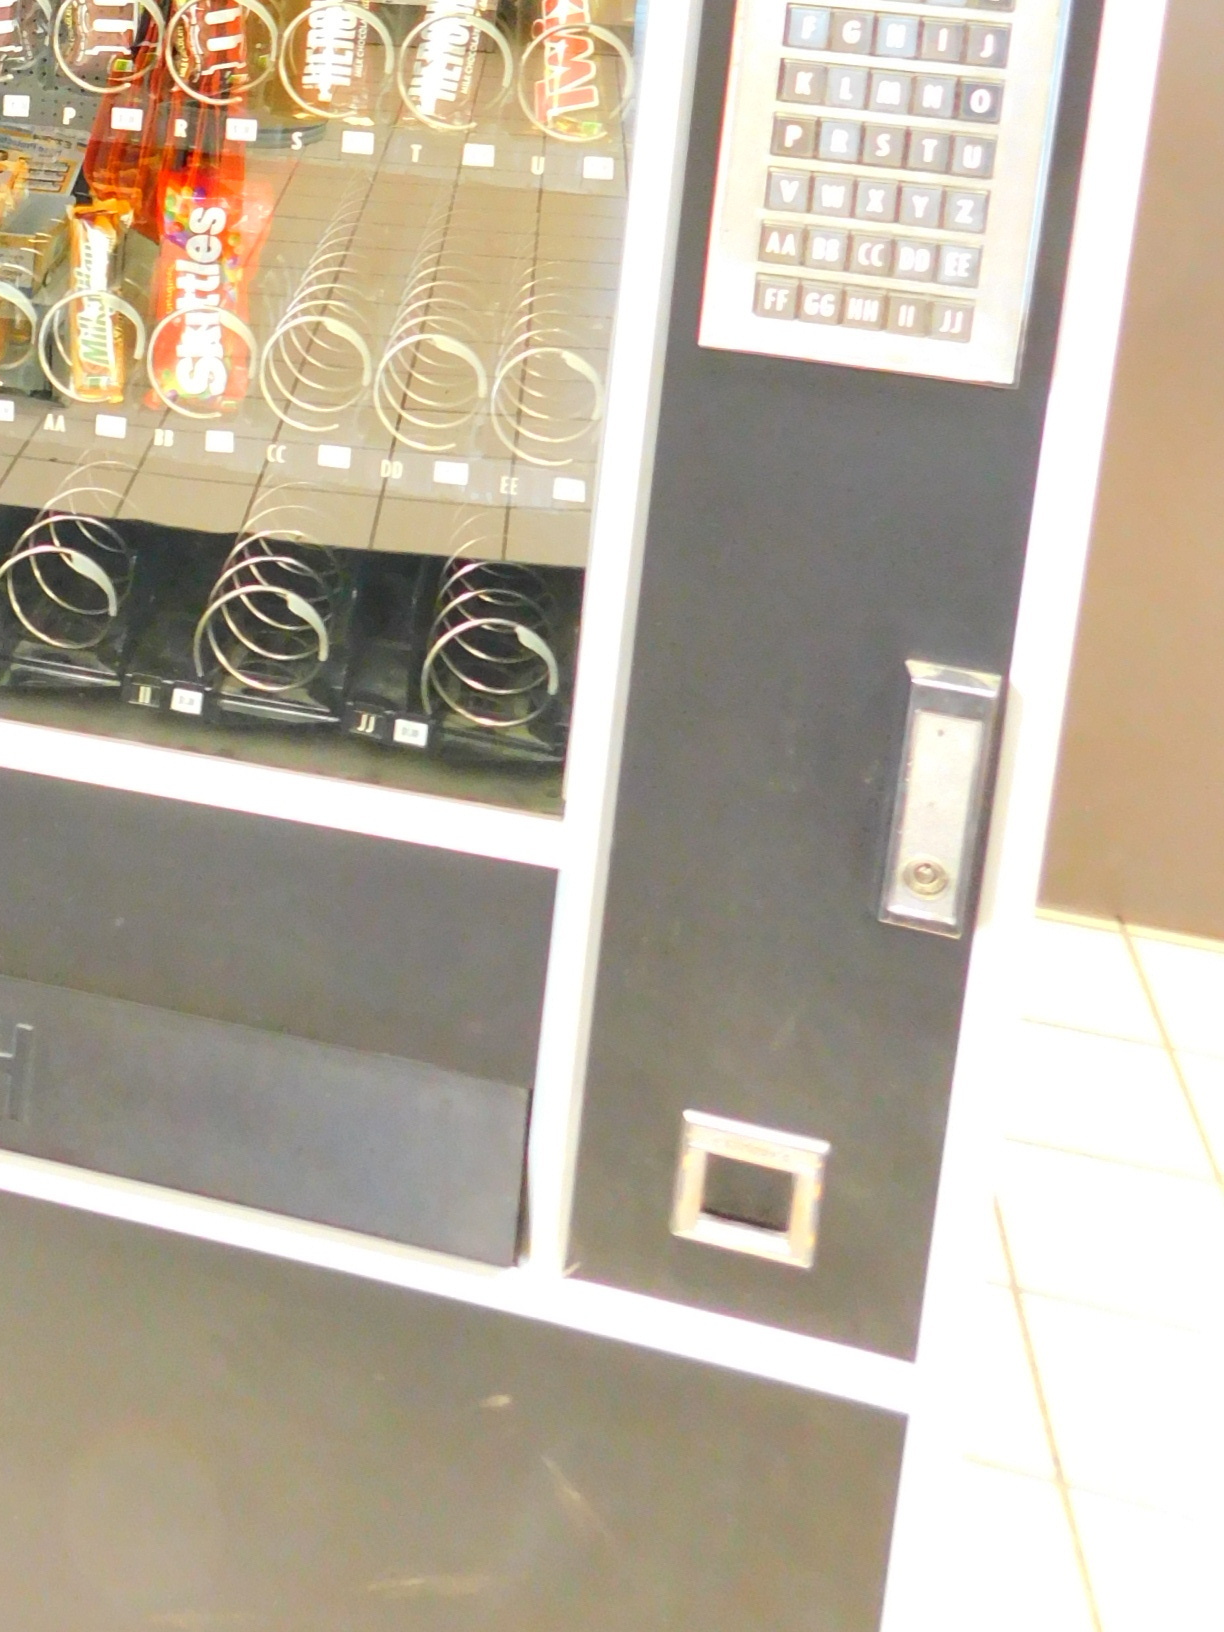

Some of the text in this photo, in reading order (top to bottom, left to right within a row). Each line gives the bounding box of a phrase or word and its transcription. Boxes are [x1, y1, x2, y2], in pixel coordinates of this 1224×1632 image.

[356, 11, 367, 59] CHOCOLA
[801, 15, 817, 39] F
[842, 20, 861, 44] G
[886, 24, 906, 47] H
[980, 33, 995, 57] J
[354, 60, 364, 78] MILK
[460, 76, 471, 95] MILK
[795, 72, 812, 95] K
[841, 76, 852, 99] L
[877, 80, 901, 105] M
[923, 84, 943, 107] N
[63, 107, 76, 125] P
[175, 119, 187, 138] R
[785, 125, 802, 147] P
[291, 131, 303, 150] S
[831, 129, 848, 152] R
[875, 134, 890, 156] S
[922, 138, 939, 162] T
[410, 144, 422, 162] T
[963, 145, 982, 168] U
[531, 156, 545, 175] U
[780, 180, 799, 203] V
[821, 184, 845, 207] W
[867, 189, 883, 212] X
[913, 194, 929, 218] Y
[955, 199, 974, 222] Z
[766, 234, 795, 256] AA
[812, 237, 840, 261] BB
[857, 243, 884, 267] CC
[900, 248, 929, 272] DD
[946, 252, 972, 277] EE
[176, 207, 227, 395] Skittles
[764, 288, 789, 311] FF
[804, 293, 835, 317] GG
[847, 297, 877, 321] HH
[940, 310, 962, 333] JJ
[43, 414, 66, 432] AA
[154, 429, 174, 447] BB
[267, 444, 287, 463] CC
[380, 459, 403, 479] DD
[499, 476, 519, 495] EE
[358, 713, 376, 733] JJ
